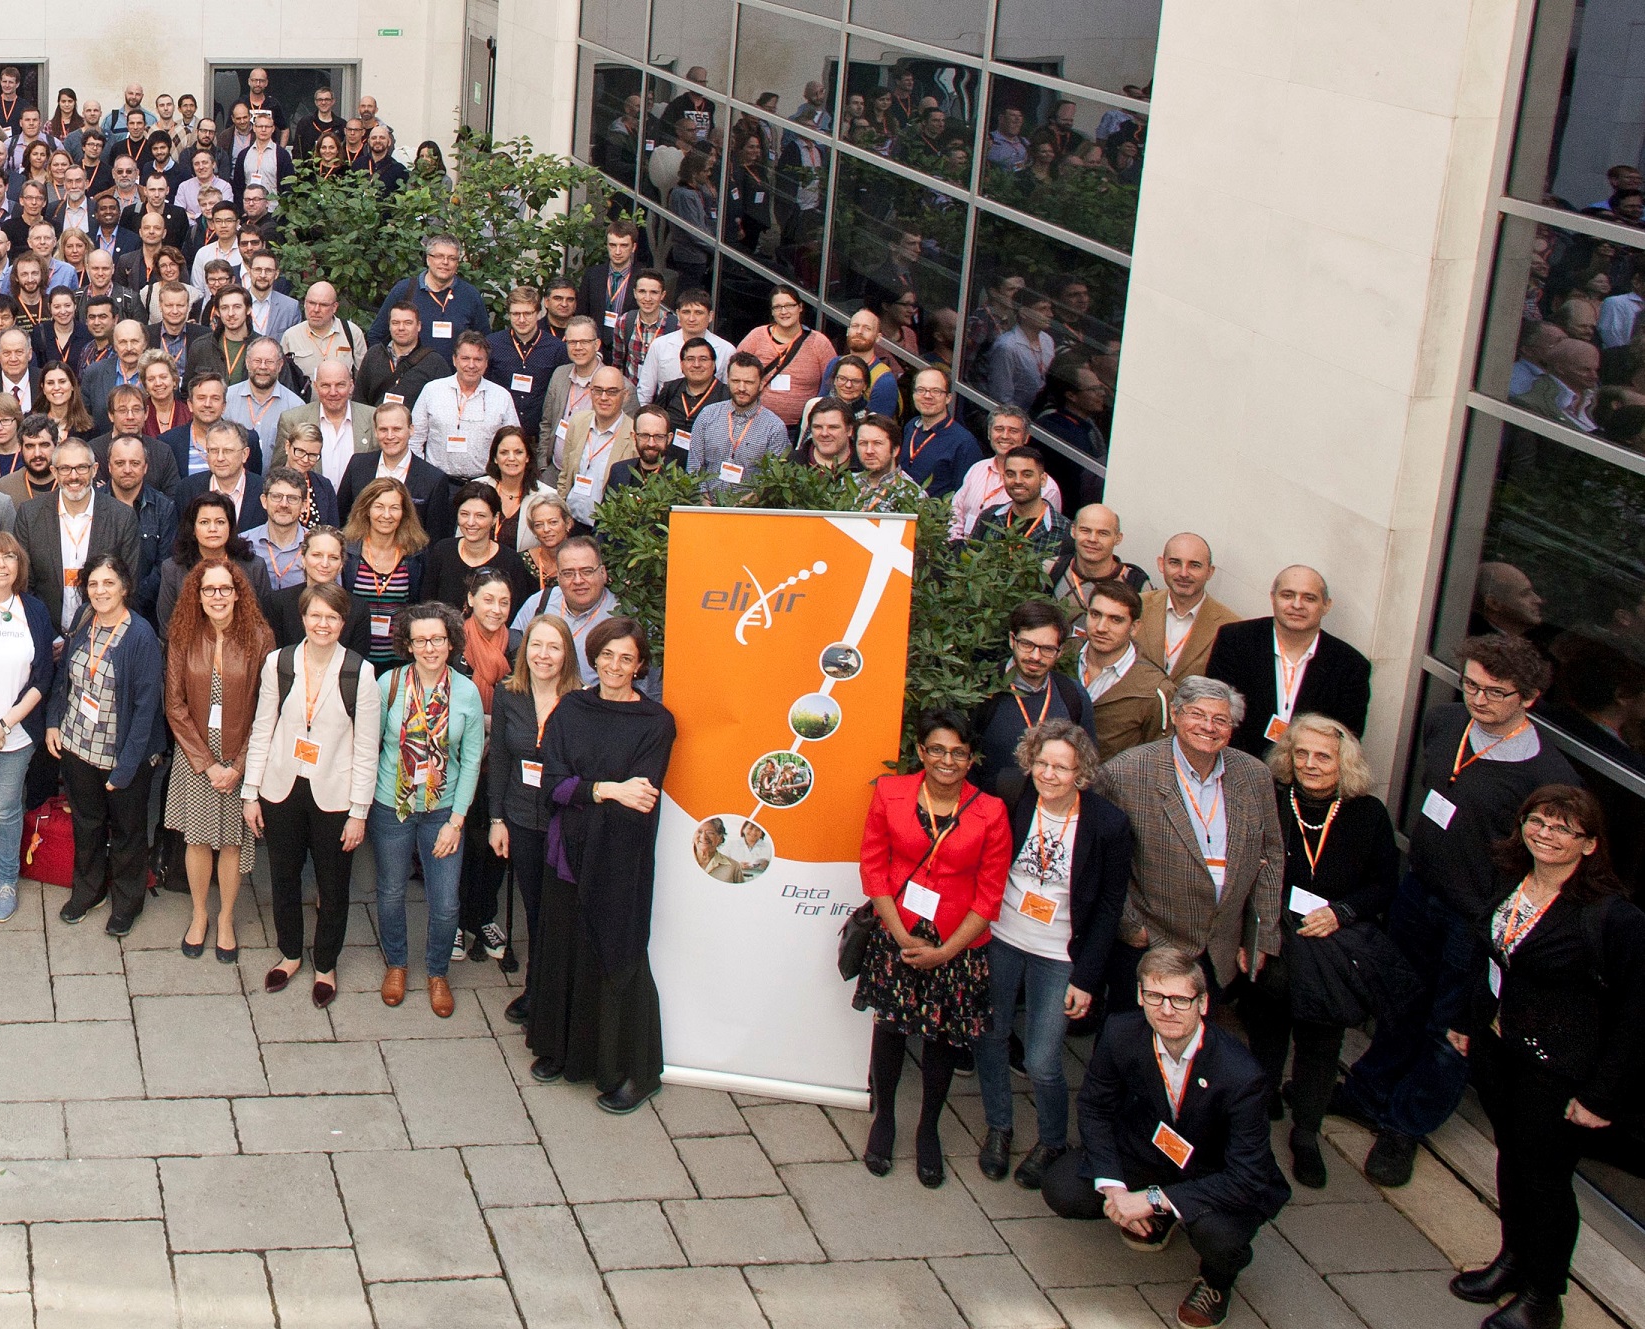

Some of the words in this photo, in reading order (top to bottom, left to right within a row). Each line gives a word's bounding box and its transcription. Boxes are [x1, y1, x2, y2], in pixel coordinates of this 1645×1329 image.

[701, 565, 807, 645] elixir
[781, 884, 830, 899] Data
[795, 902, 825, 916] for
